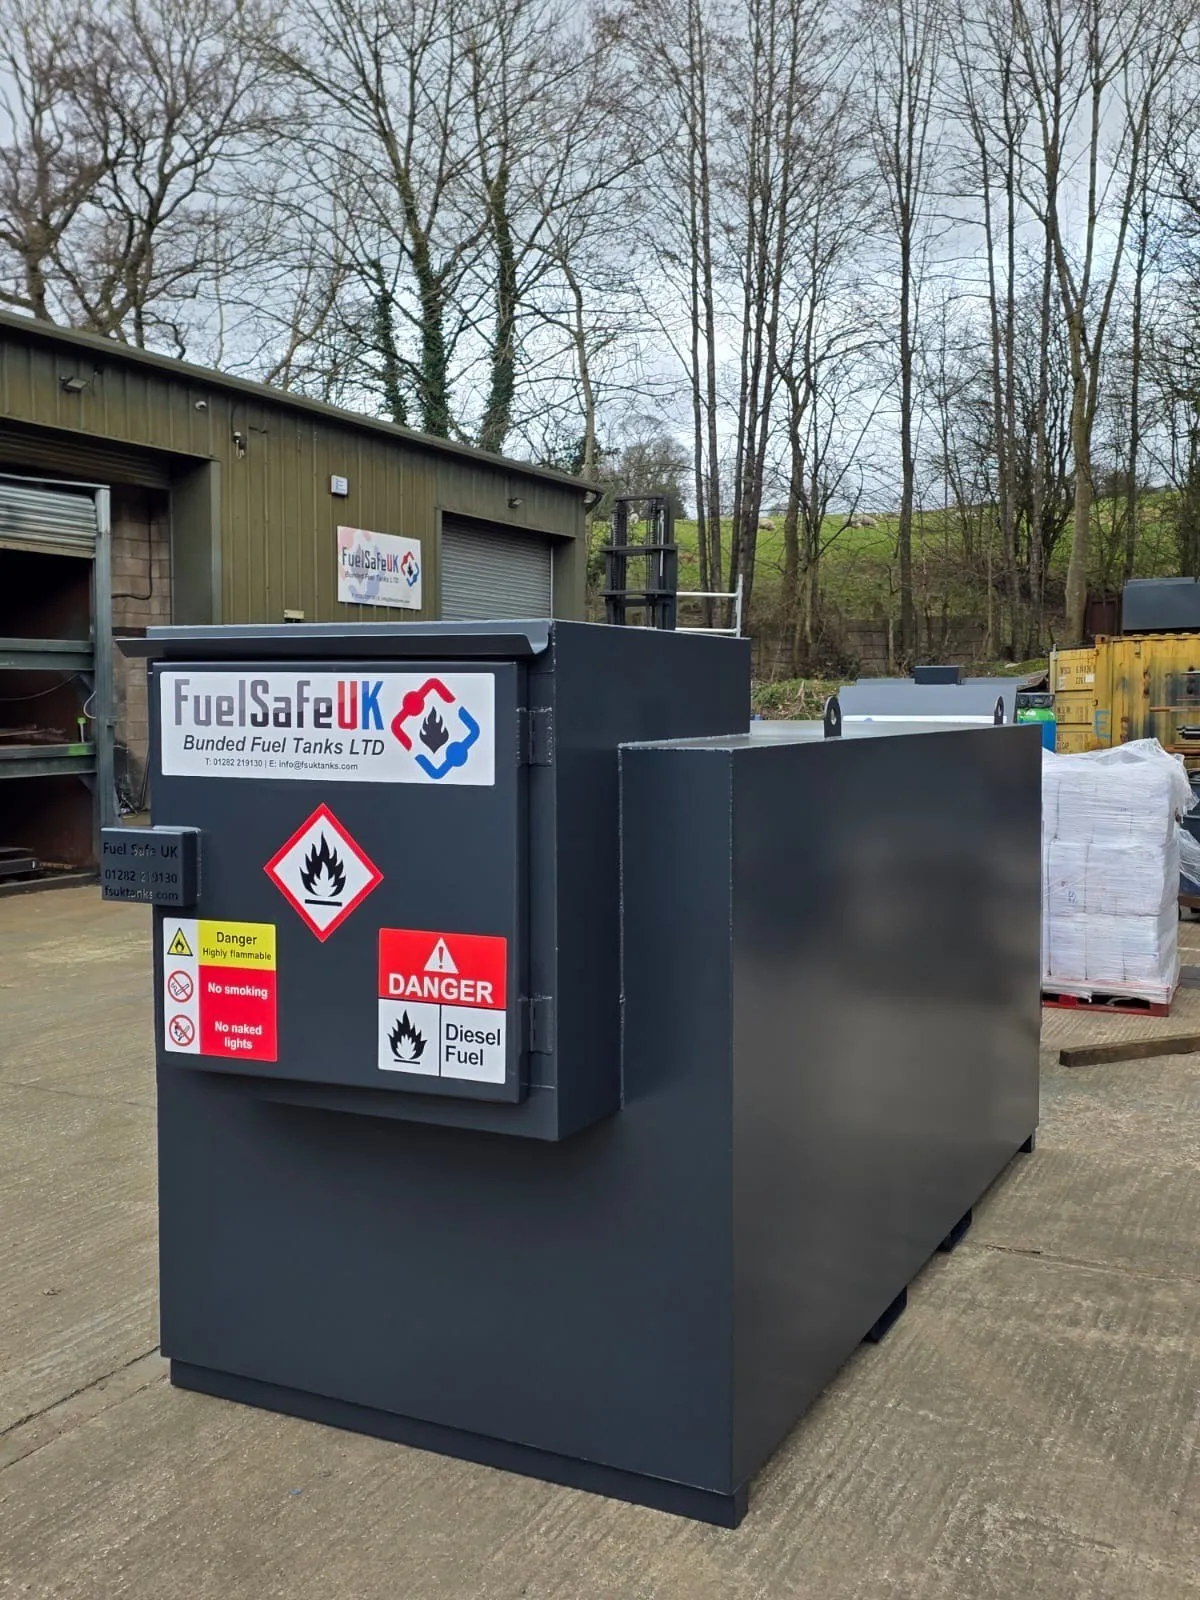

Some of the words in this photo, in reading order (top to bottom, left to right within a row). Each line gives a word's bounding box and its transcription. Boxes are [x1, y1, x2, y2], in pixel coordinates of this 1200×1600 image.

[342, 547, 399, 573] FuelSafeUK
[174, 678, 385, 731] FuelSafeUK
[183, 735, 246, 753] Bunded
[250, 736, 286, 754] Fuel
[293, 738, 343, 755] Tanks
[349, 739, 385, 756] LTD
[205, 758, 212, 767] T:
[213, 758, 235, 767] 01282
[237, 758, 262, 768] 219130
[269, 760, 277, 768] E:
[279, 760, 358, 771] info@fsuktanks.com
[103, 842, 126, 855] Fuel
[131, 843, 156, 857] Safe
[161, 845, 178, 859] UK
[105, 869, 136, 882] 01282
[140, 871, 178, 884] 219130
[216, 931, 257, 947] Danger
[203, 948, 227, 959] Highly
[230, 949, 272, 961] flammable
[208, 982, 222, 993] No
[224, 983, 268, 1000] smoking
[389, 972, 494, 1004] DANGER
[214, 1021, 229, 1032] No
[231, 1023, 262, 1035] naked
[446, 1023, 501, 1046] Diesel
[224, 1037, 253, 1050] lights
[446, 1045, 483, 1066] Fuel
